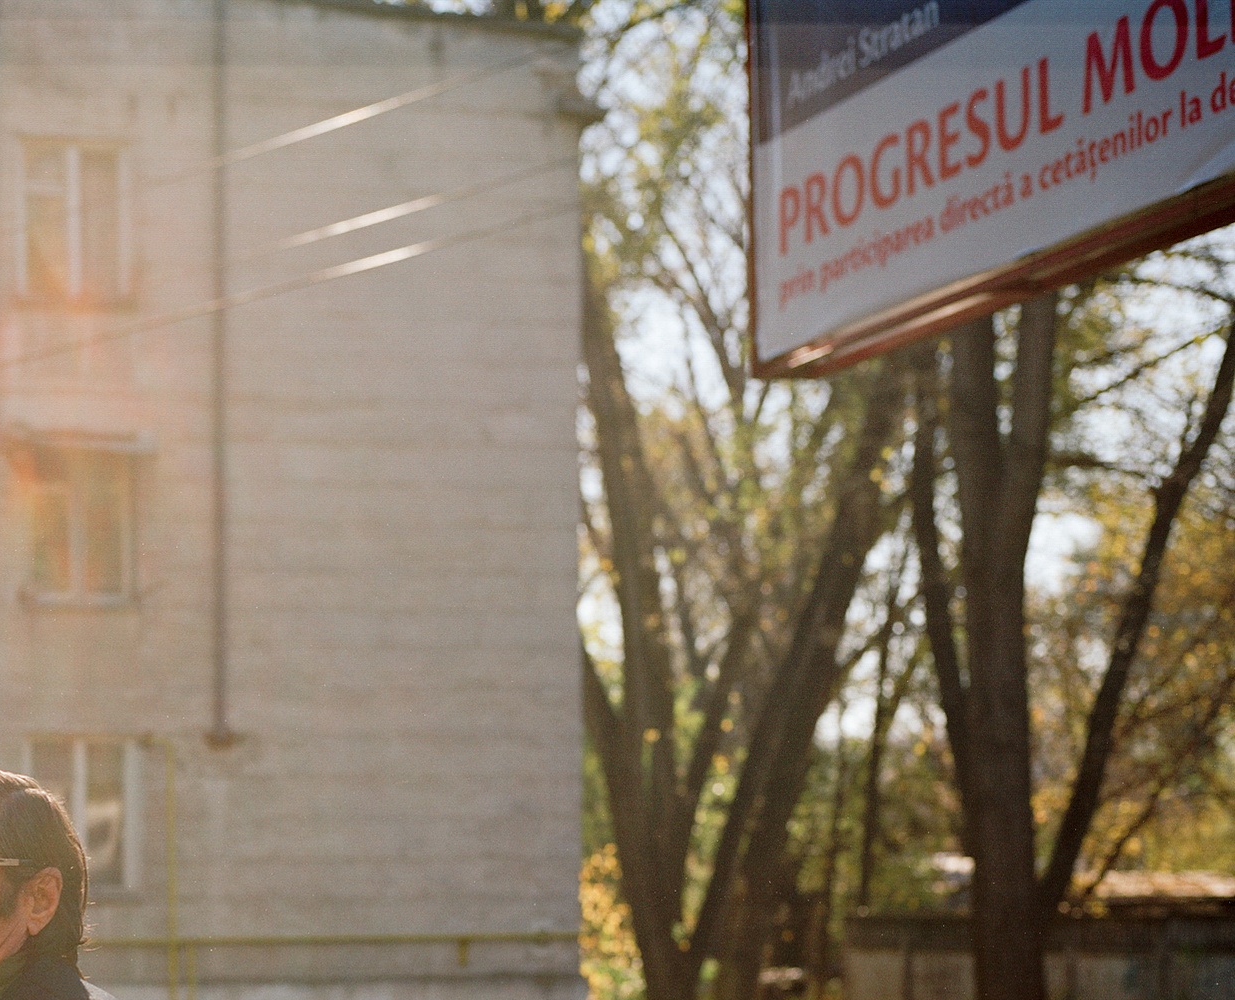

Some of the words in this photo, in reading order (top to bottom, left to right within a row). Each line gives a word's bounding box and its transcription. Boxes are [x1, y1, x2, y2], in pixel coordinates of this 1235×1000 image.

[778, 58, 1064, 257] PROGRESUL
[1082, 0, 1235, 115] MOL
[787, 35, 856, 108] Andrei
[858, 1, 939, 67] Stratan
[778, 265, 815, 310] prin
[818, 216, 935, 292] participarea
[1021, 172, 1033, 198] a
[1180, 89, 1202, 128] la
